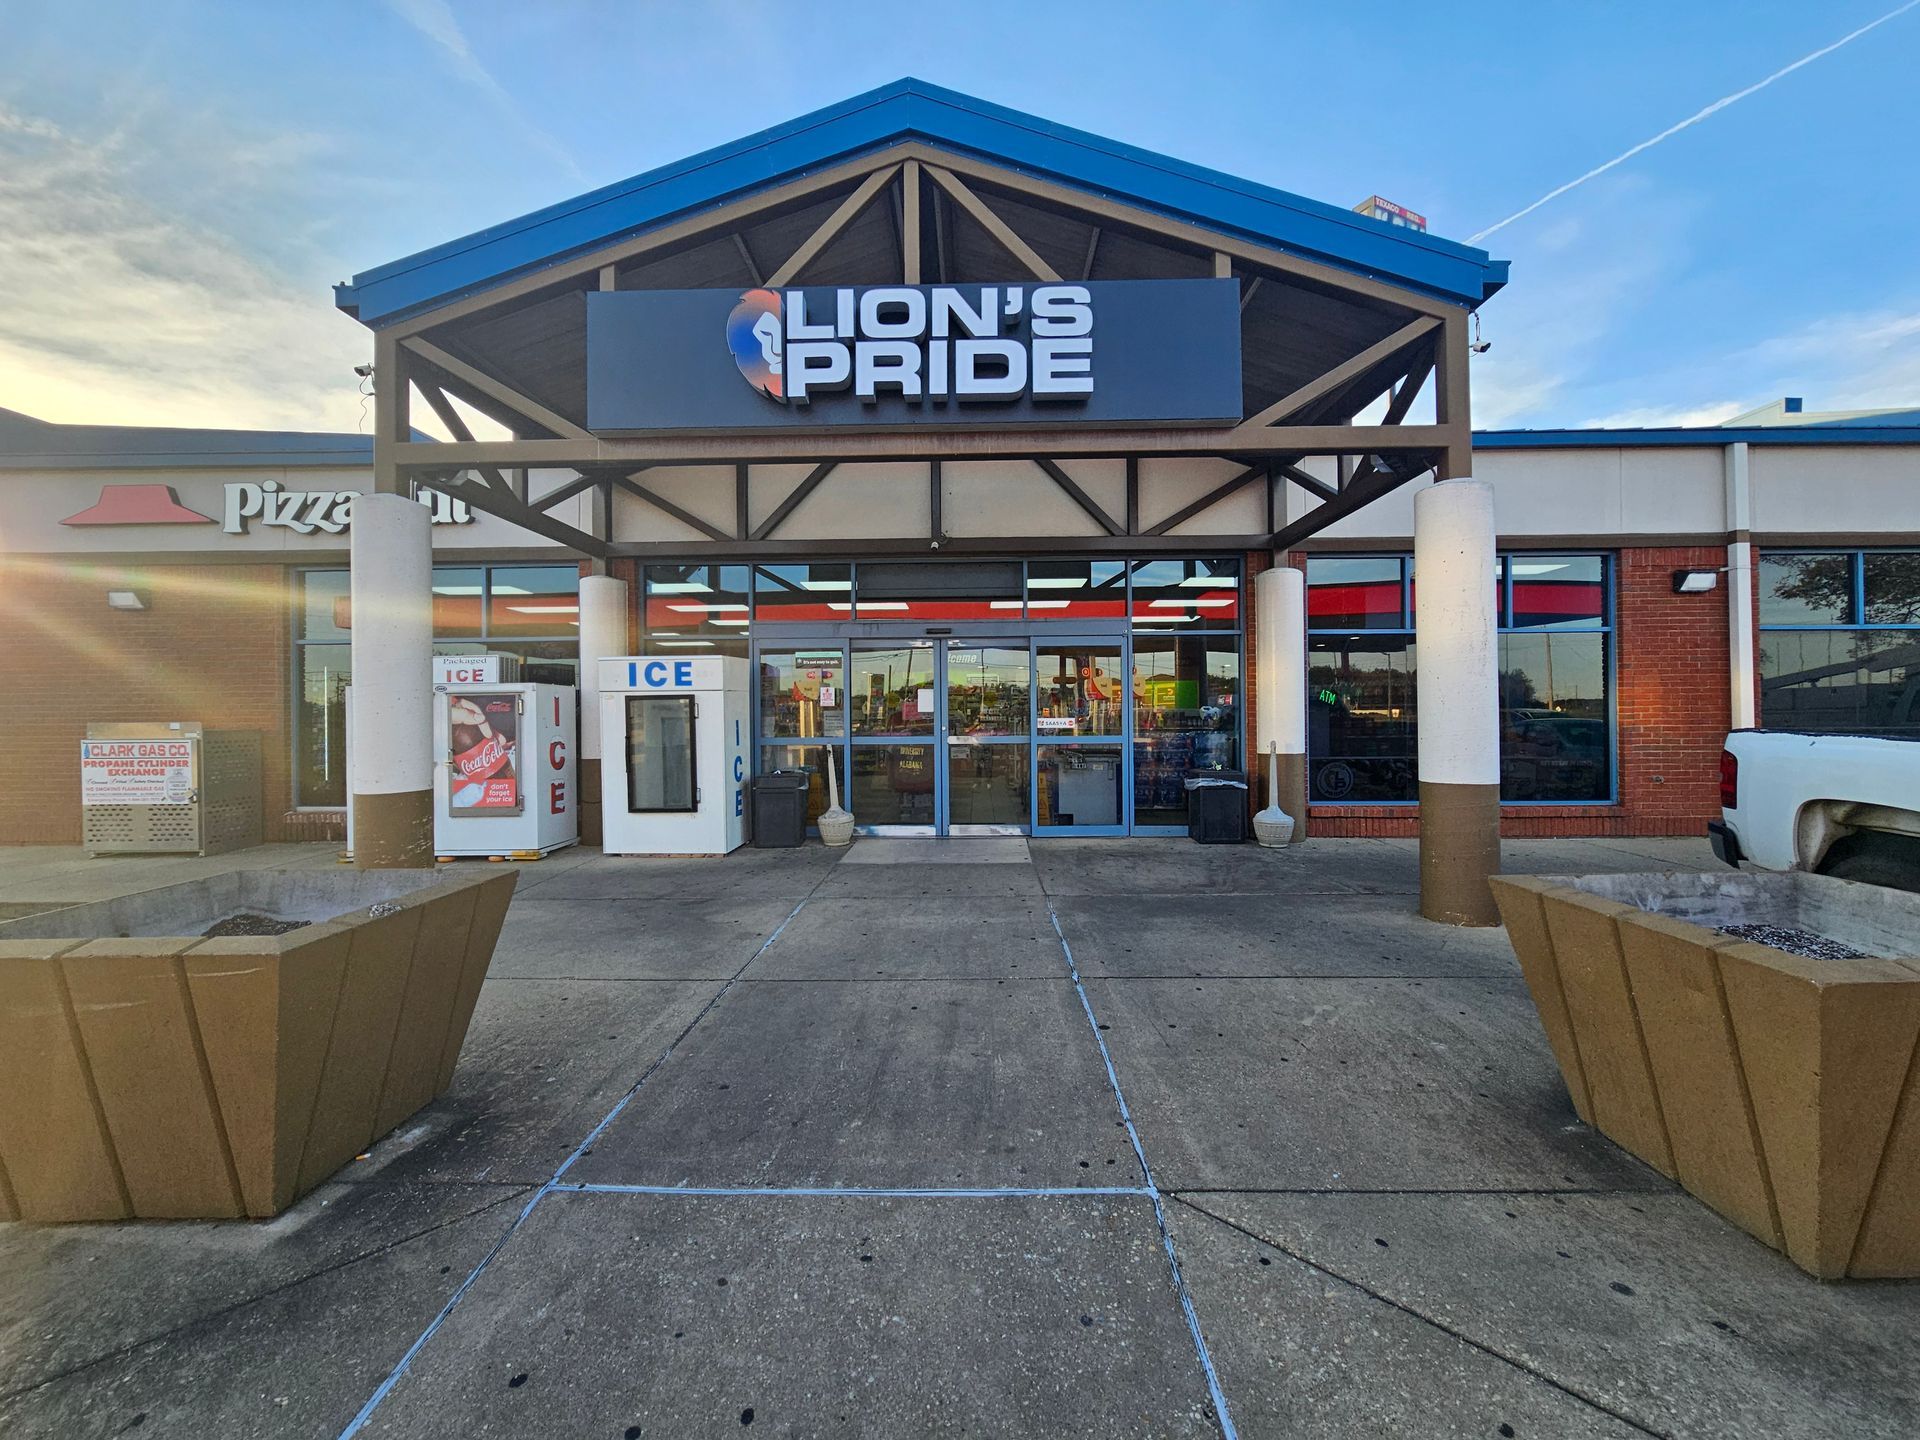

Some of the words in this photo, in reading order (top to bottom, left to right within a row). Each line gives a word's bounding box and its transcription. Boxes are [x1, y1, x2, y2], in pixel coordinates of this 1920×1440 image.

[1375, 197, 1400, 214] TEXACO
[786, 285, 1093, 340] LION'S
[786, 338, 1094, 400] PRIDE
[223, 479, 352, 534] Pizza
[409, 478, 473, 524] ut
[443, 657, 487, 665] Packaged
[446, 668, 484, 683] ICE
[628, 661, 693, 687] ICE
[1319, 689, 1337, 705] ATM
[90, 744, 135, 757] CLARK
[138, 744, 166, 757] GAS
[168, 744, 190, 757] CO.
[461, 738, 504, 775] Coca-Cola
[549, 696, 566, 815] ICE
[83, 760, 135, 768] PROPANE
[137, 759, 189, 768] CYLINDER
[107, 768, 166, 776] EXCHANGE
[733, 719, 743, 818] ICE
[489, 789, 510, 797] forget
